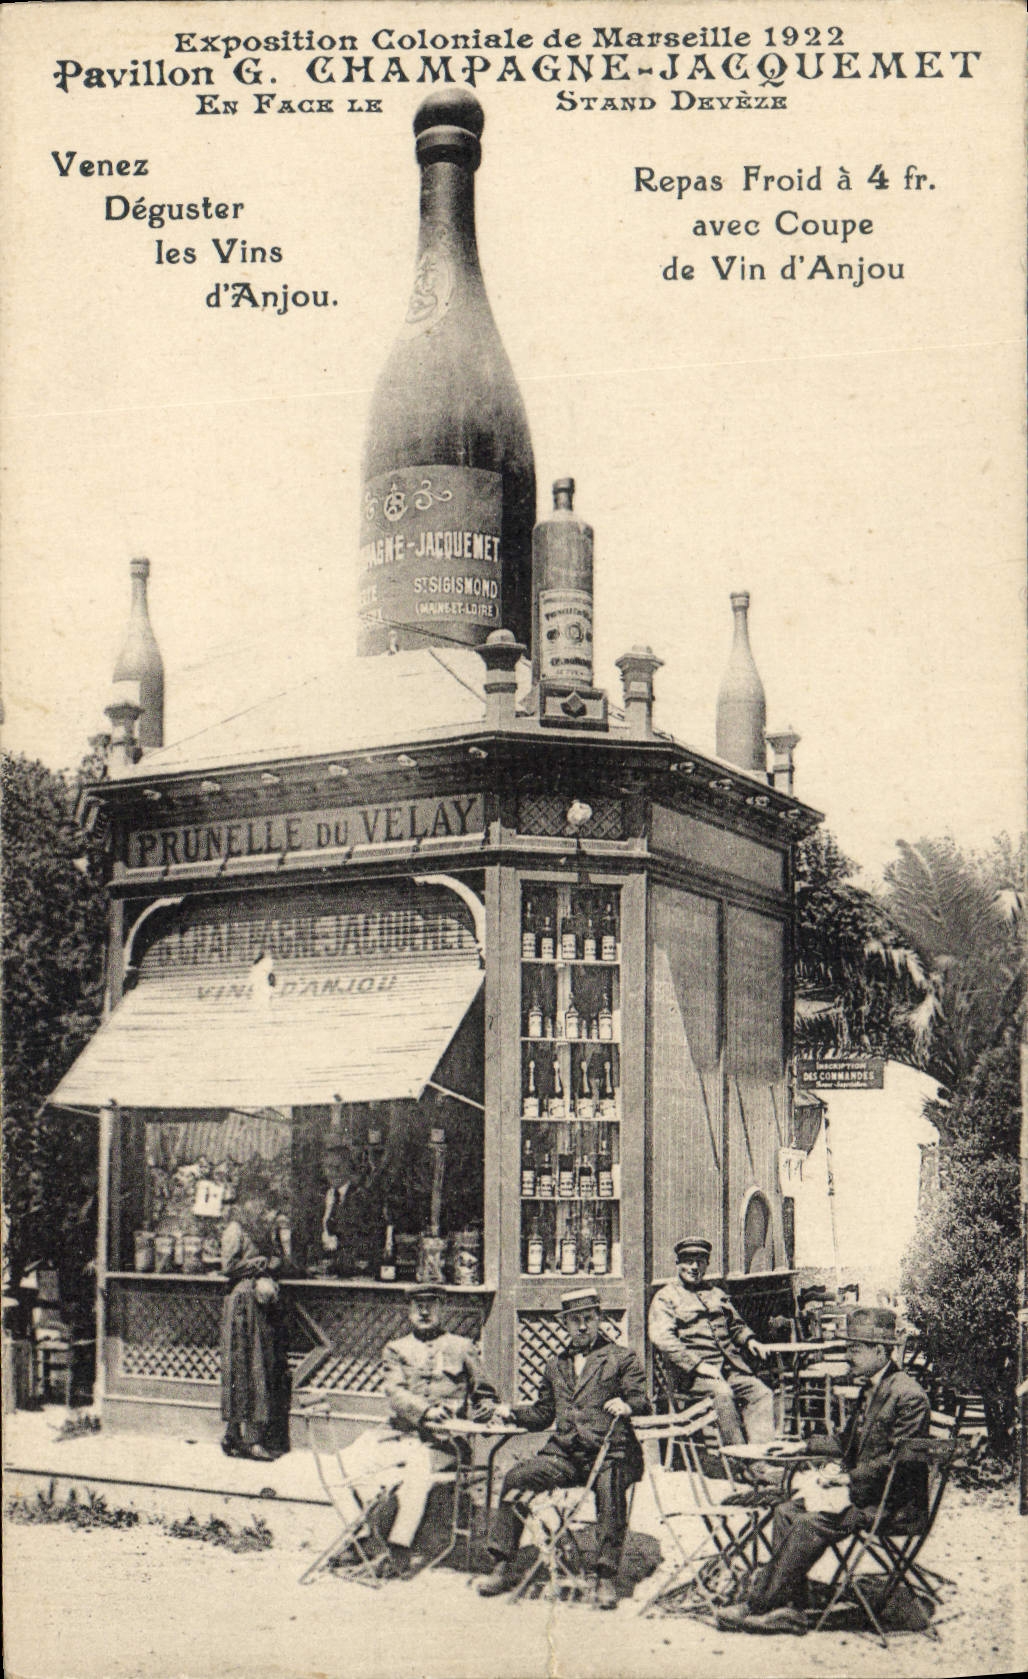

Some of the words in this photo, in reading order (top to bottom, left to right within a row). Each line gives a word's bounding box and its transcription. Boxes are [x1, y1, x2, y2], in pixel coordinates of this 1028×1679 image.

[429, 576, 498, 599] SIGISMOND
[137, 817, 302, 867] PRUNELLE
[316, 821, 348, 848] DU
[359, 798, 477, 844] VELAY
[803, 1071, 817, 1081] DES
[819, 1071, 875, 1080] COMMANDES
